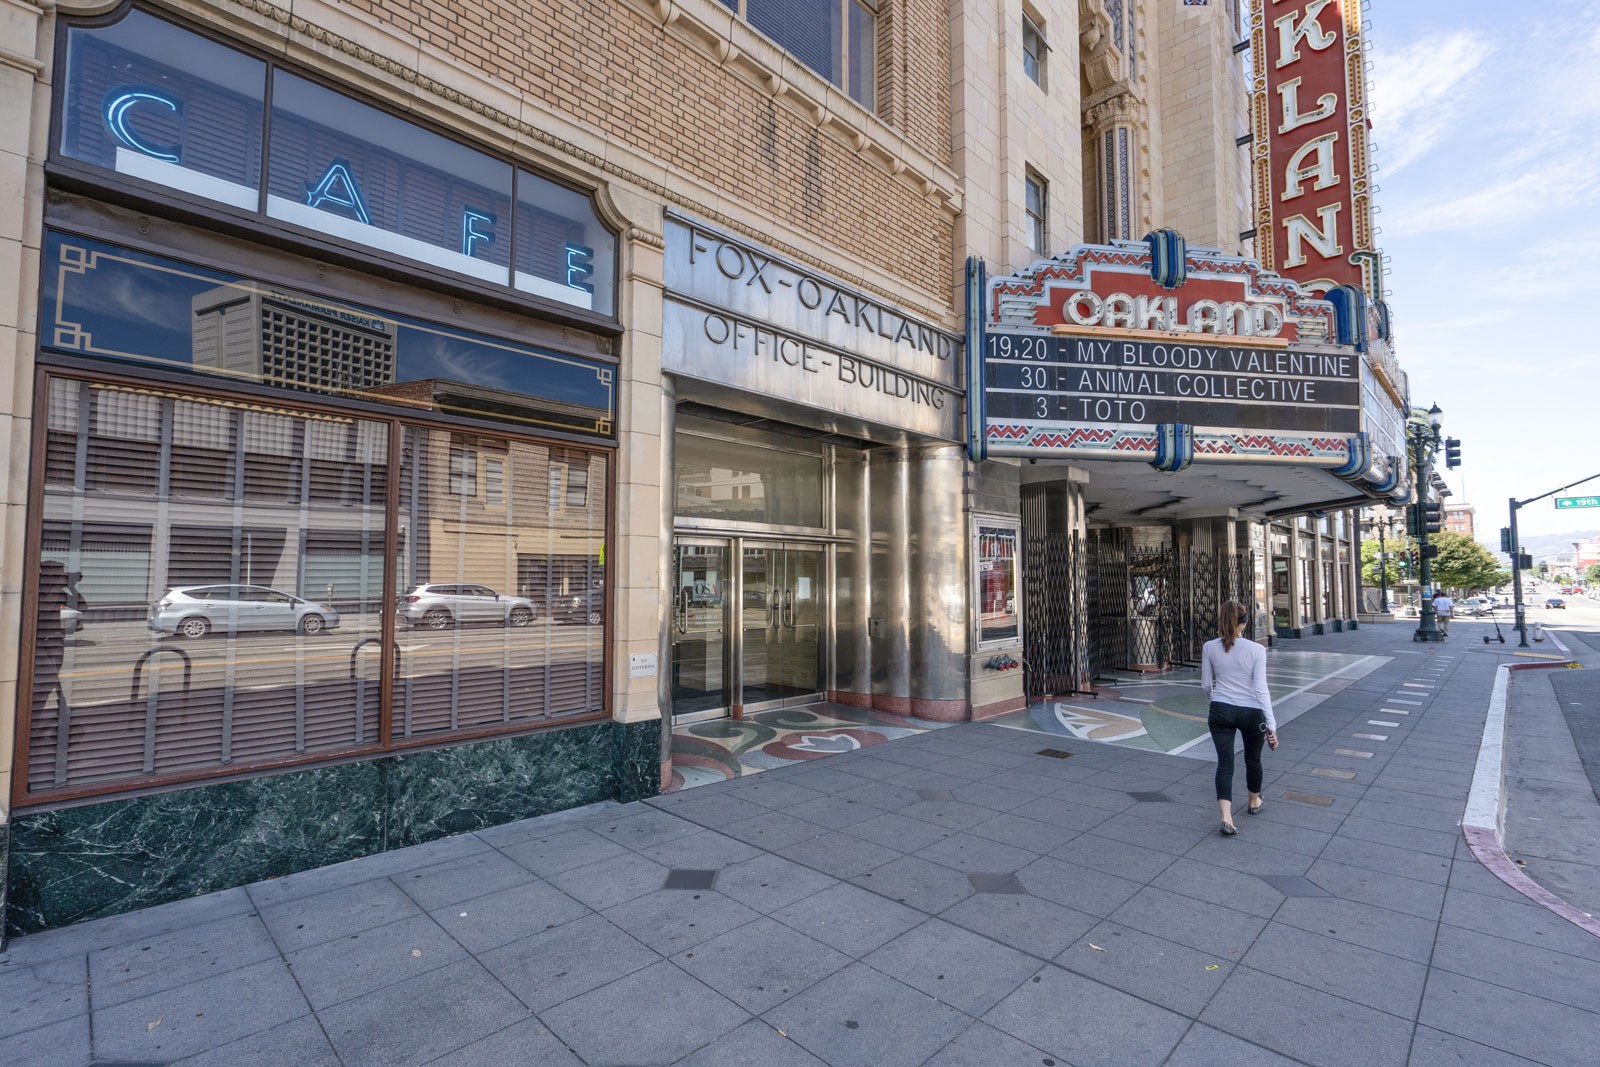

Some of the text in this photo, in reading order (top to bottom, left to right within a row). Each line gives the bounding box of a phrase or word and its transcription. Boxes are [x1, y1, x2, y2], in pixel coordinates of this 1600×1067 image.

[1272, 0, 1344, 297] KLAN
[102, 82, 595, 294] CAFE
[689, 227, 951, 361] FOX-OAKLAND
[1063, 290, 1284, 338] OAKLAND
[704, 313, 945, 410] OFFICE-BUILDING
[988, 335, 1048, 361] 19,20
[1078, 341, 1112, 364] MY
[1124, 344, 1218, 368] BLOODY
[1231, 350, 1352, 377] VALENTINE
[1021, 366, 1047, 389] 30
[1078, 370, 1166, 394] ANIMAL
[1176, 375, 1316, 402] COLLECTIVE
[1036, 396, 1048, 419] 3
[1082, 398, 1147, 422] TOTO
[1575, 498, 1598, 506] 19th
